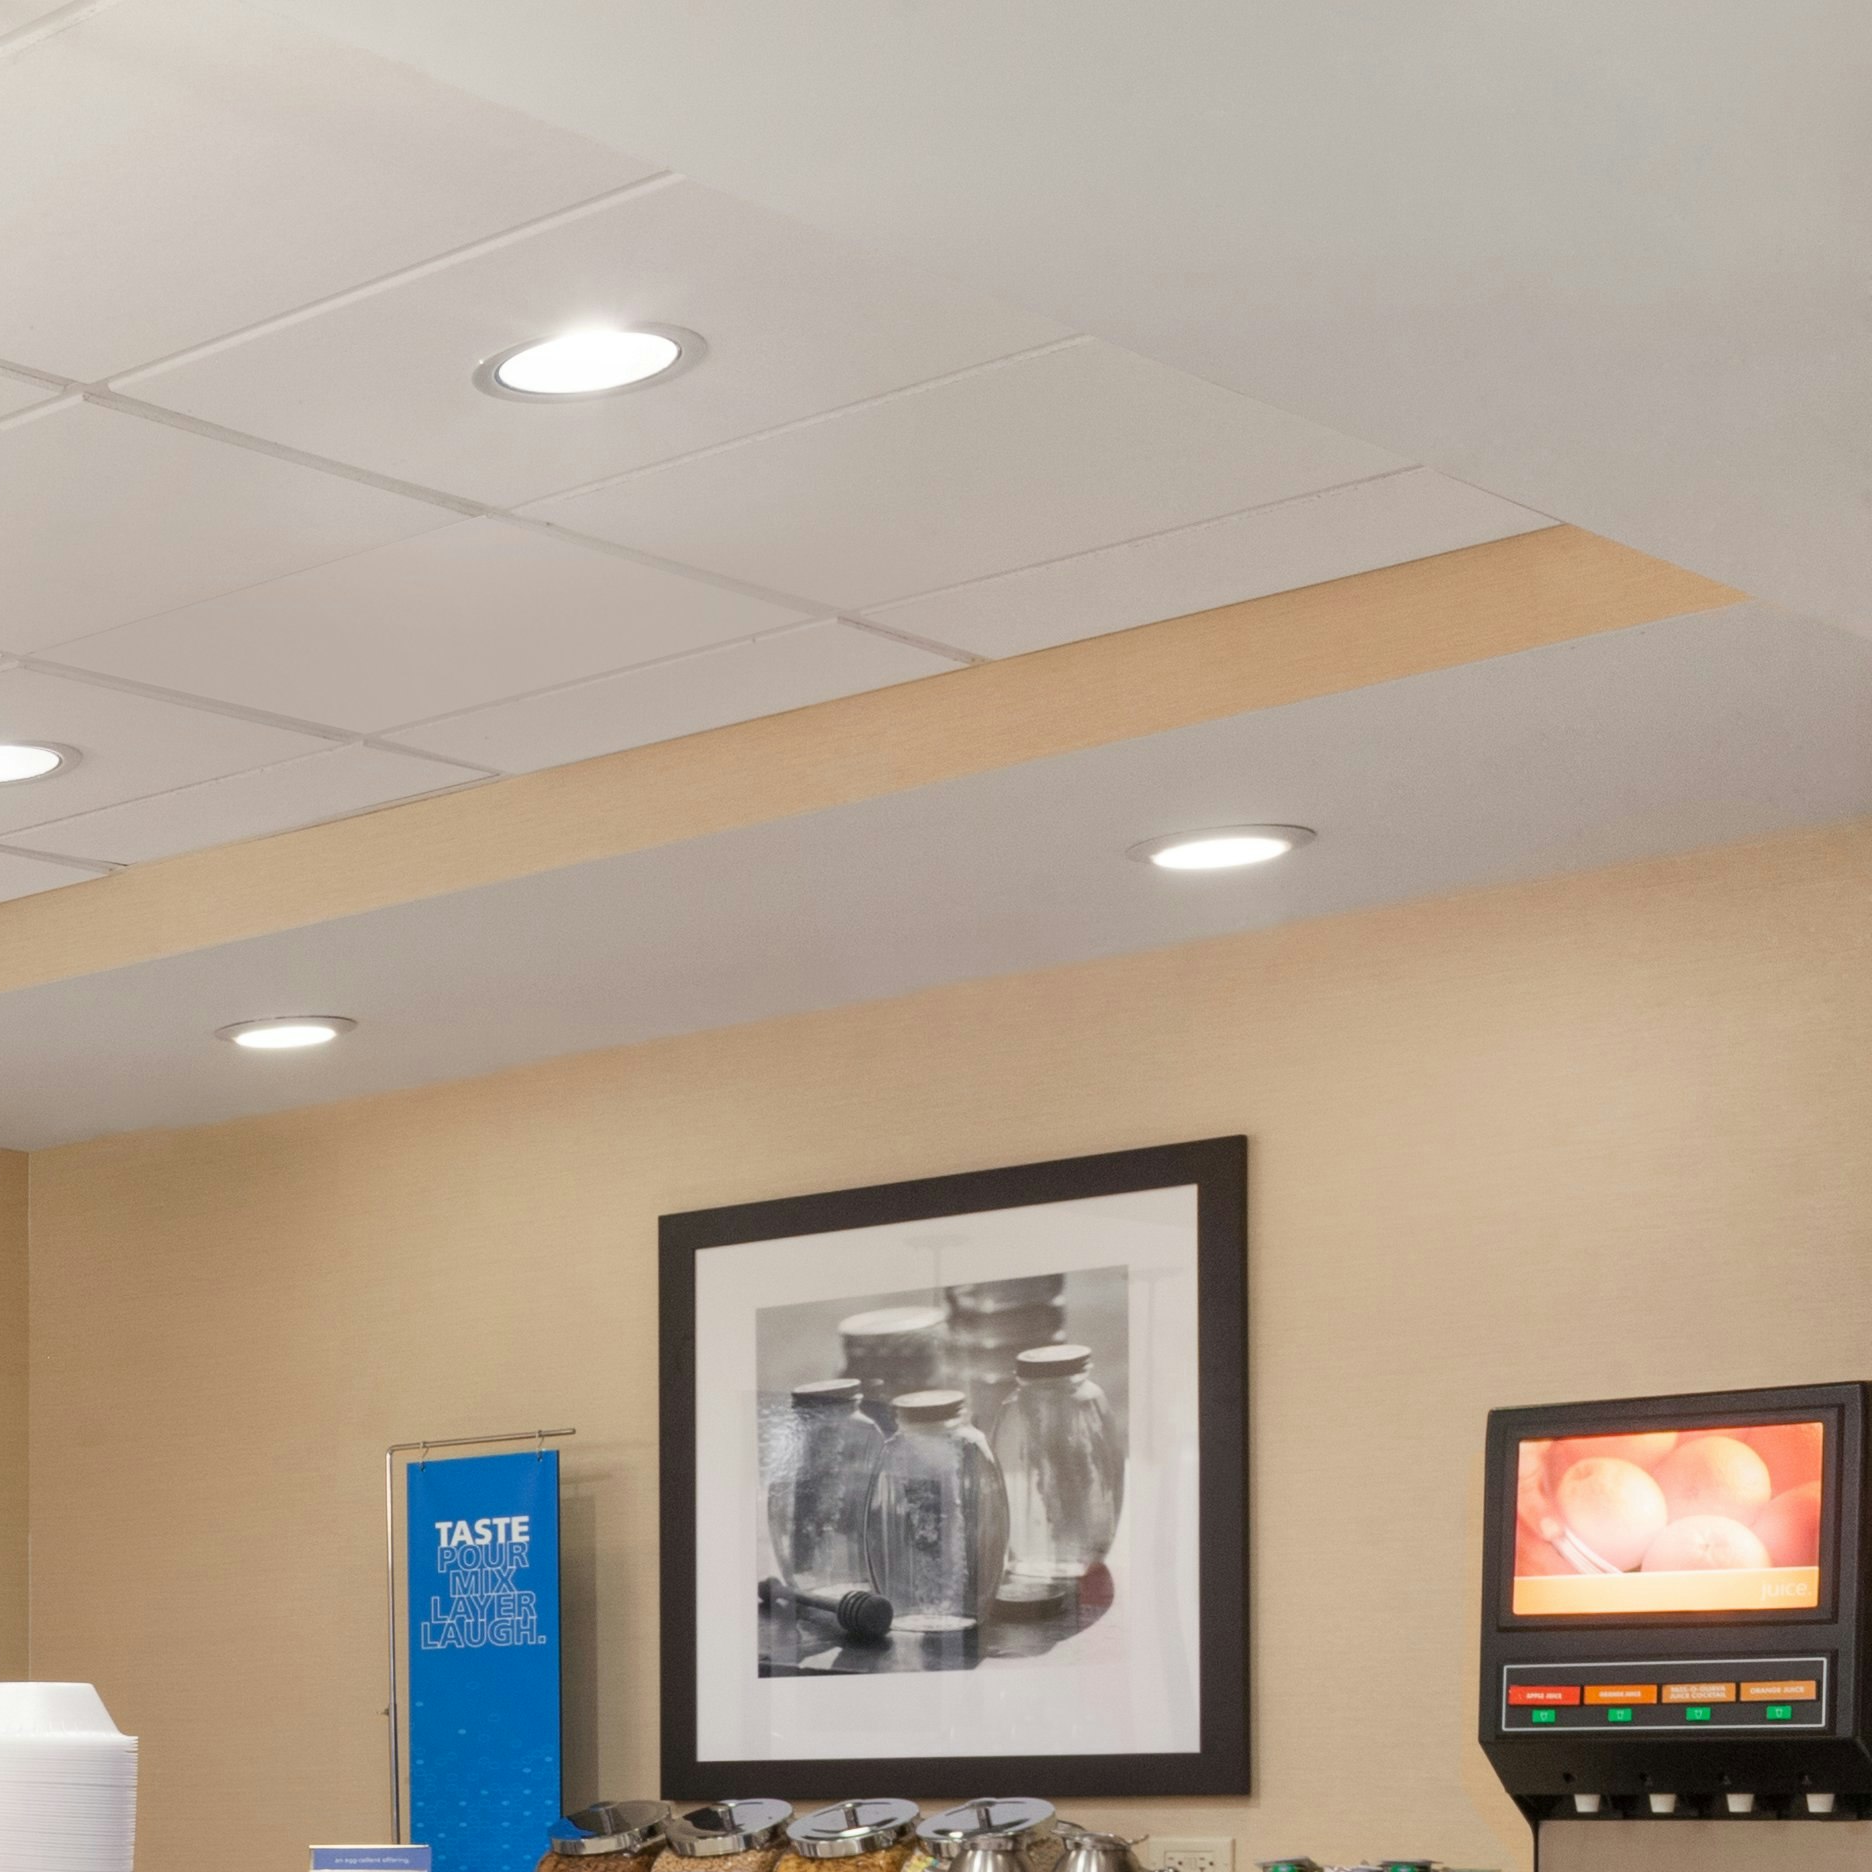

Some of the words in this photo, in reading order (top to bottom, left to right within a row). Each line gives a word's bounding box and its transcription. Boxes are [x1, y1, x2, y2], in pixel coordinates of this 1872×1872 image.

[435, 1516, 529, 1547] TASTE
[438, 1541, 529, 1573] POUR
[450, 1566, 516, 1597] MIX
[431, 1591, 537, 1623] LAYER
[421, 1617, 546, 1650] LAUGH.
[1750, 1687, 1782, 1695] ORANGE
[1783, 1686, 1804, 1694] JUICE
